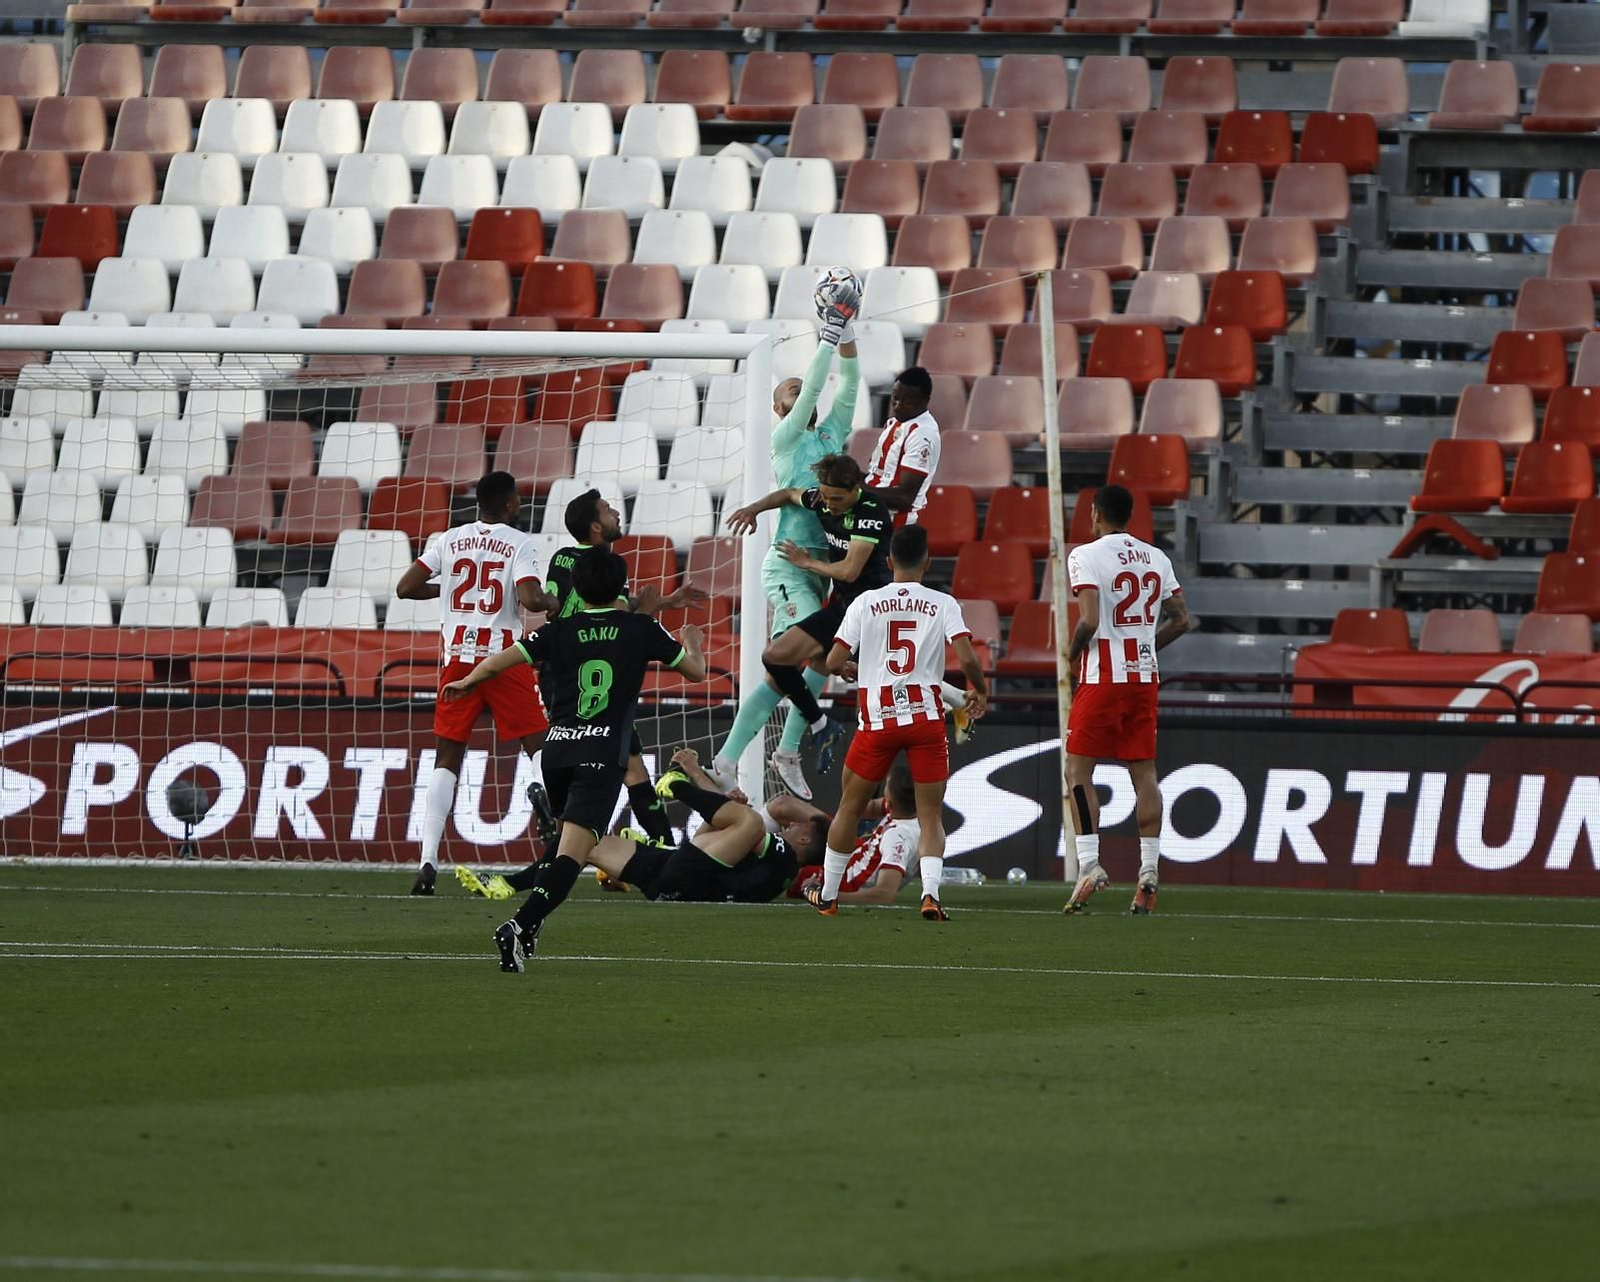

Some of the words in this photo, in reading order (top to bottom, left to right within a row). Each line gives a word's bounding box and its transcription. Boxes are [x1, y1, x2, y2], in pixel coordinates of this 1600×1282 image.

[857, 519, 883, 531] KFC
[450, 537, 514, 558] FERNANDES
[555, 554, 576, 572] BOR
[1118, 551, 1151, 566] SAMU
[450, 557, 505, 615] 25
[870, 598, 938, 617] MORLANES
[1112, 570, 1162, 627] 22
[577, 626, 619, 643] GAKU
[886, 620, 918, 677] 5
[576, 659, 613, 720] 8
